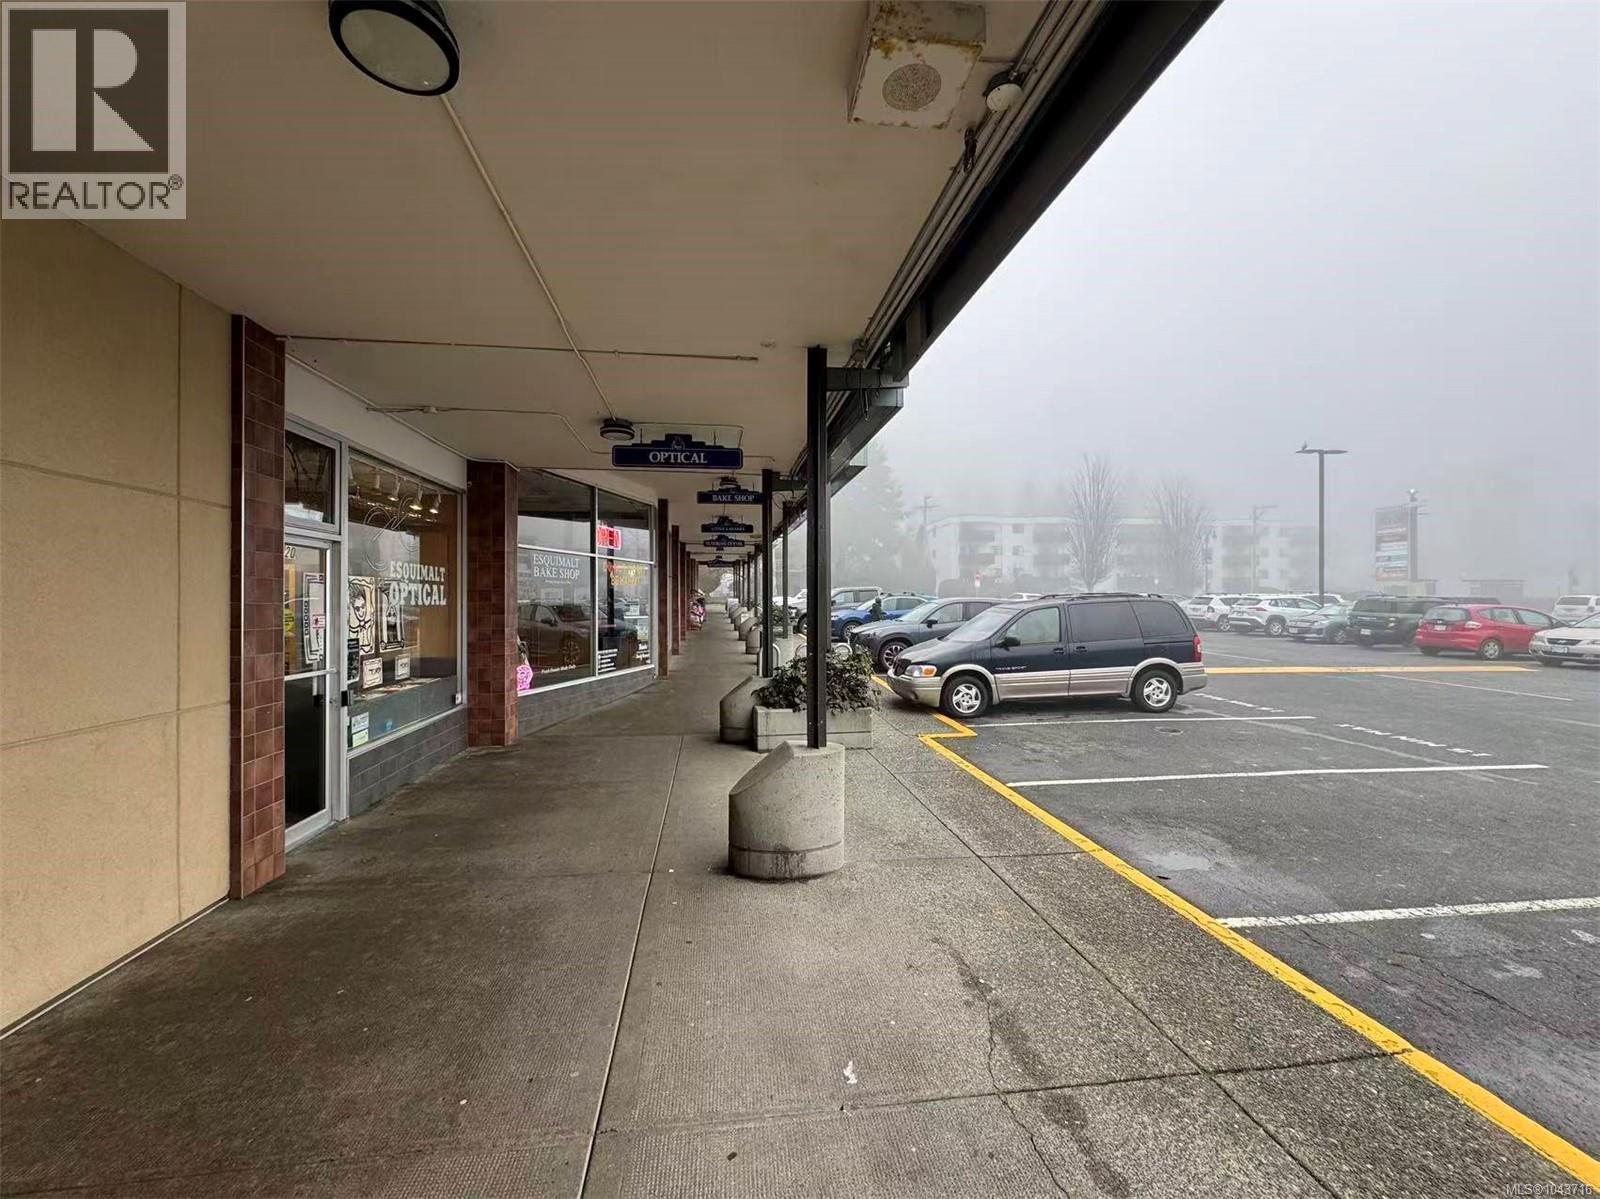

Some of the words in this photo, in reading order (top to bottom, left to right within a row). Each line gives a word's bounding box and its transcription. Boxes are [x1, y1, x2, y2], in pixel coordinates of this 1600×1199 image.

[648, 451, 708, 464] OPTICAL
[712, 494, 732, 502] BAKE
[733, 494, 755, 502] SHOP
[597, 527, 619, 549] OPEN
[533, 553, 580, 569] ESQUIMALT
[389, 561, 446, 583] ESQUIMALT
[533, 567, 558, 578] BAKE
[559, 569, 580, 580] SHOP
[388, 582, 447, 607] OPTICAL
